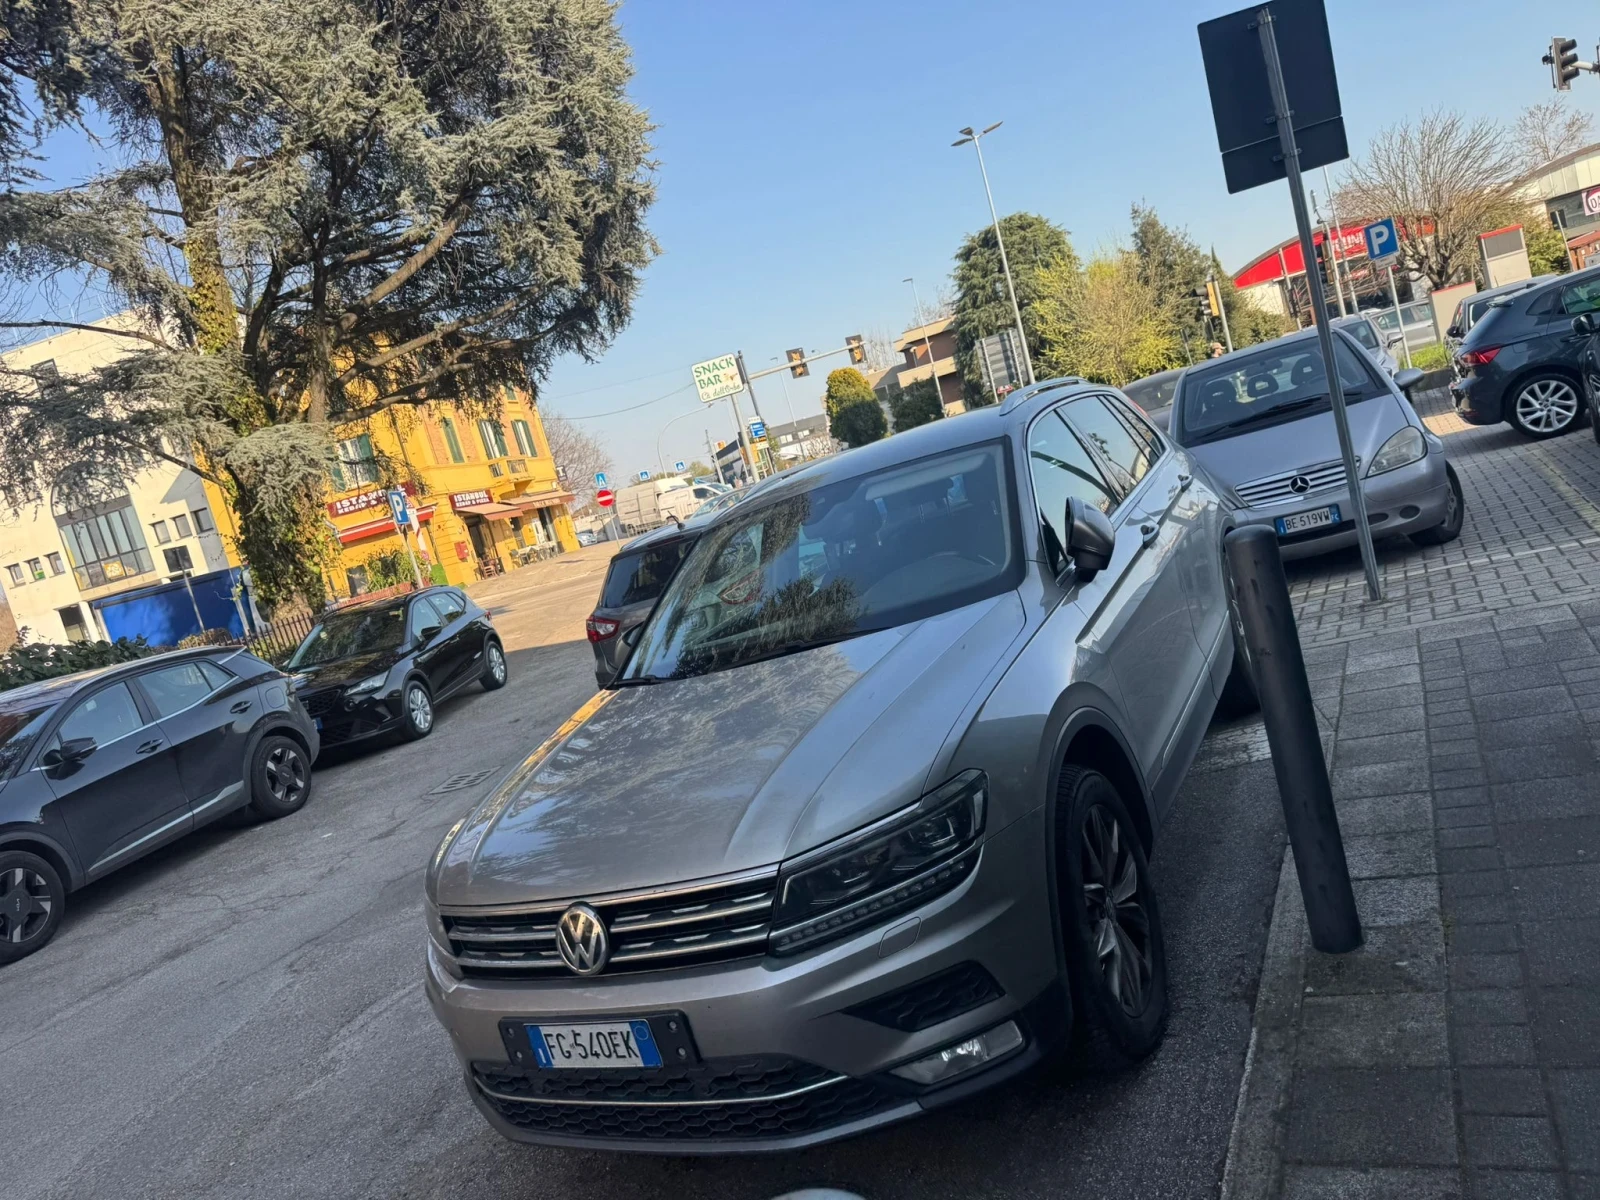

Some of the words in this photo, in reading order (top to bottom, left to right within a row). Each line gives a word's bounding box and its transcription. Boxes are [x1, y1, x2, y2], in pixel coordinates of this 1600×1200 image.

[1369, 224, 1389, 255] P
[694, 357, 735, 378] SNACK
[698, 374, 722, 389] BAR
[454, 490, 488, 502] ISTANBUL
[393, 494, 404, 520] P
[1285, 517, 1298, 530] BE
[1300, 510, 1330, 527] 519VW
[544, 1032, 571, 1060] FG
[572, 1030, 639, 1059] 540EK
